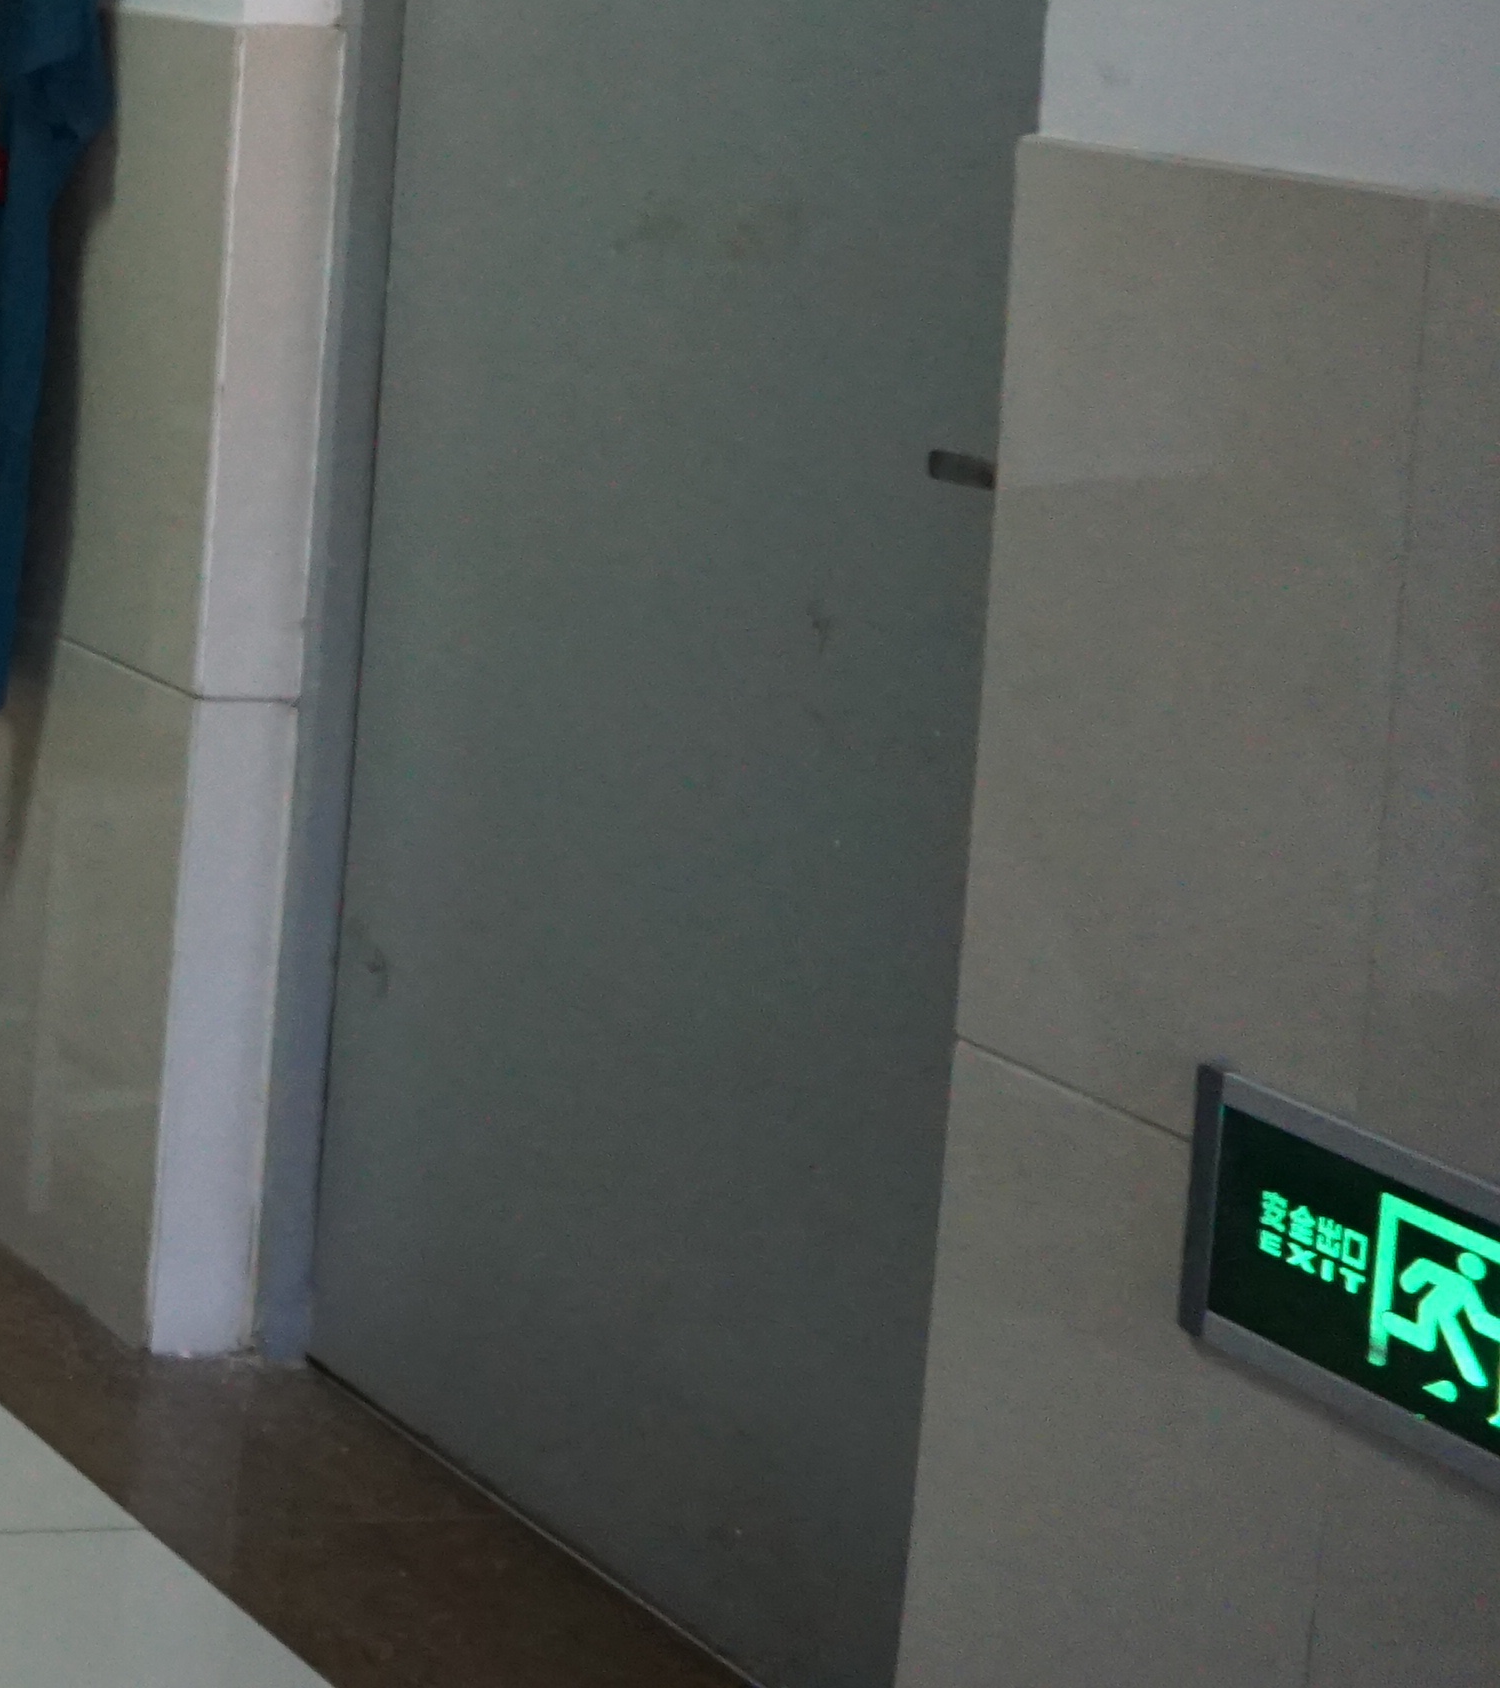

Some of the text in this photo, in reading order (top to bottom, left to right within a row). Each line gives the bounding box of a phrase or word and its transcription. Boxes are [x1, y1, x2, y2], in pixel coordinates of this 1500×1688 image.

[1259, 1229, 1367, 1295] EXIT
[1260, 1190, 1368, 1271] 安全出口
